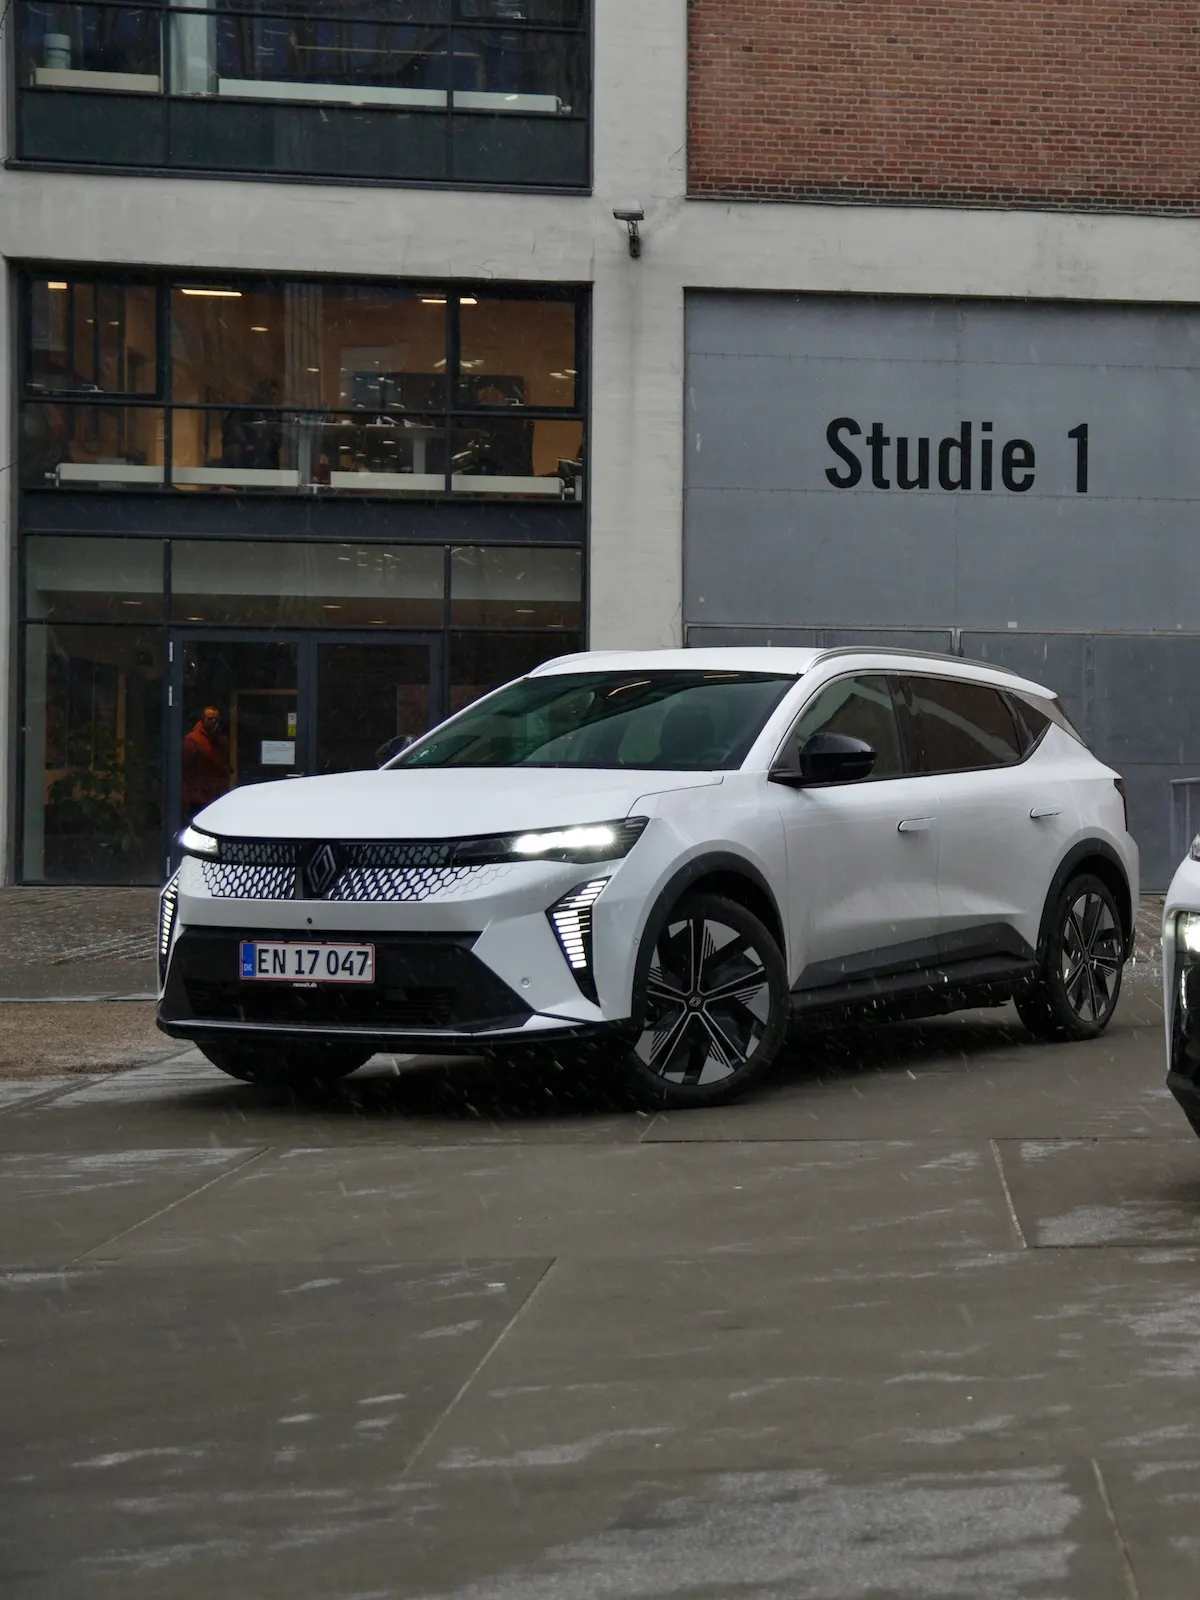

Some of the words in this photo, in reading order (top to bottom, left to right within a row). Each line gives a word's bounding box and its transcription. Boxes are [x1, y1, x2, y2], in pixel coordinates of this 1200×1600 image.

[825, 417, 1035, 492] Studie
[1067, 423, 1088, 493] 1
[243, 963, 253, 972] DK
[258, 948, 286, 974] EN
[295, 950, 320, 975] 17
[326, 950, 370, 976] 047
